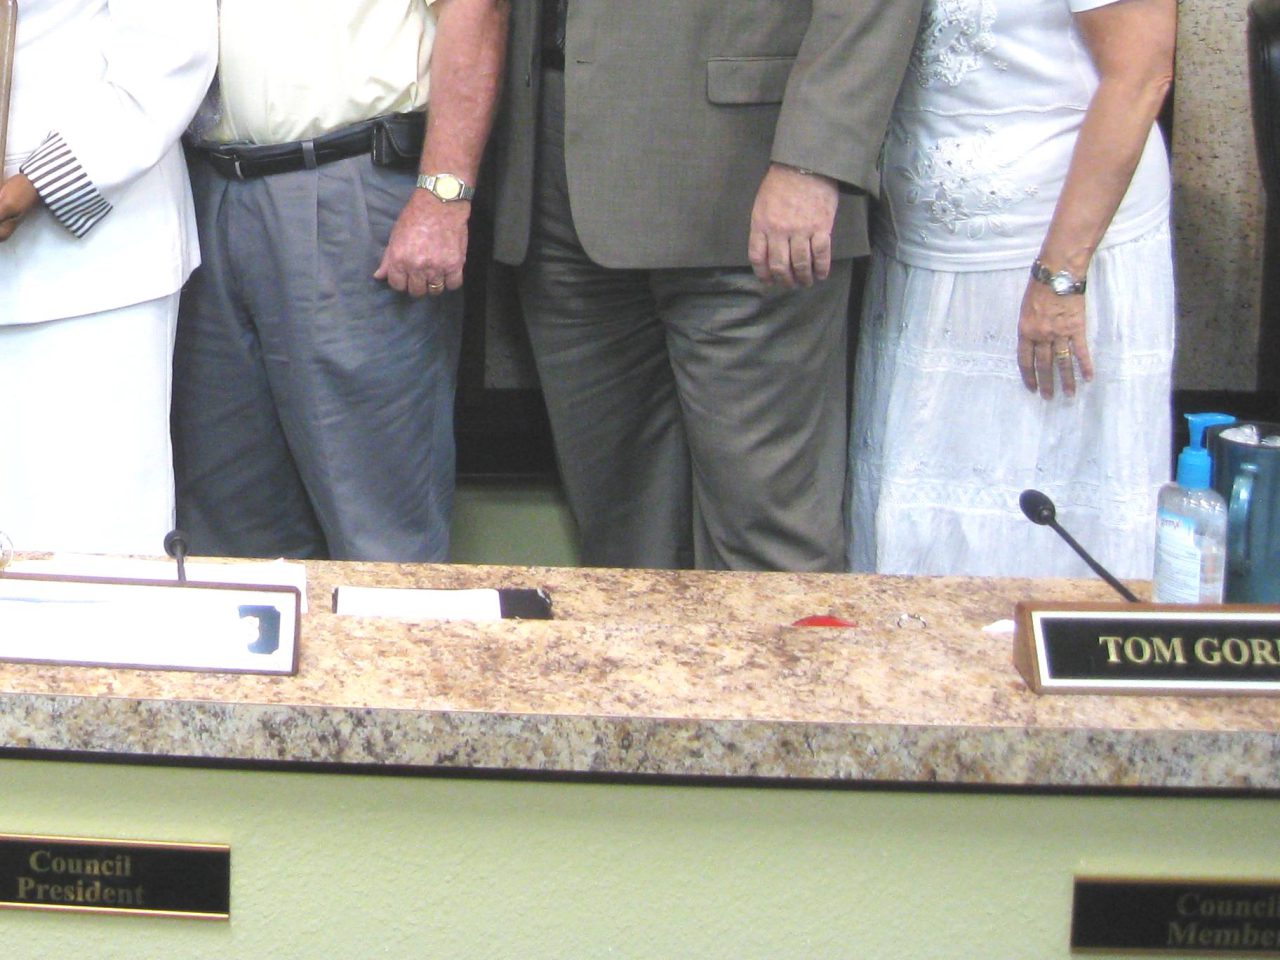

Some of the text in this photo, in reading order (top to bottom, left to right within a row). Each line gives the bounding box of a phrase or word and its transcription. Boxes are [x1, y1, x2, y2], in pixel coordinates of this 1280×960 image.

[1099, 636, 1280, 665] TOM GOR
[28, 849, 132, 877] Council
[16, 876, 145, 906] President
